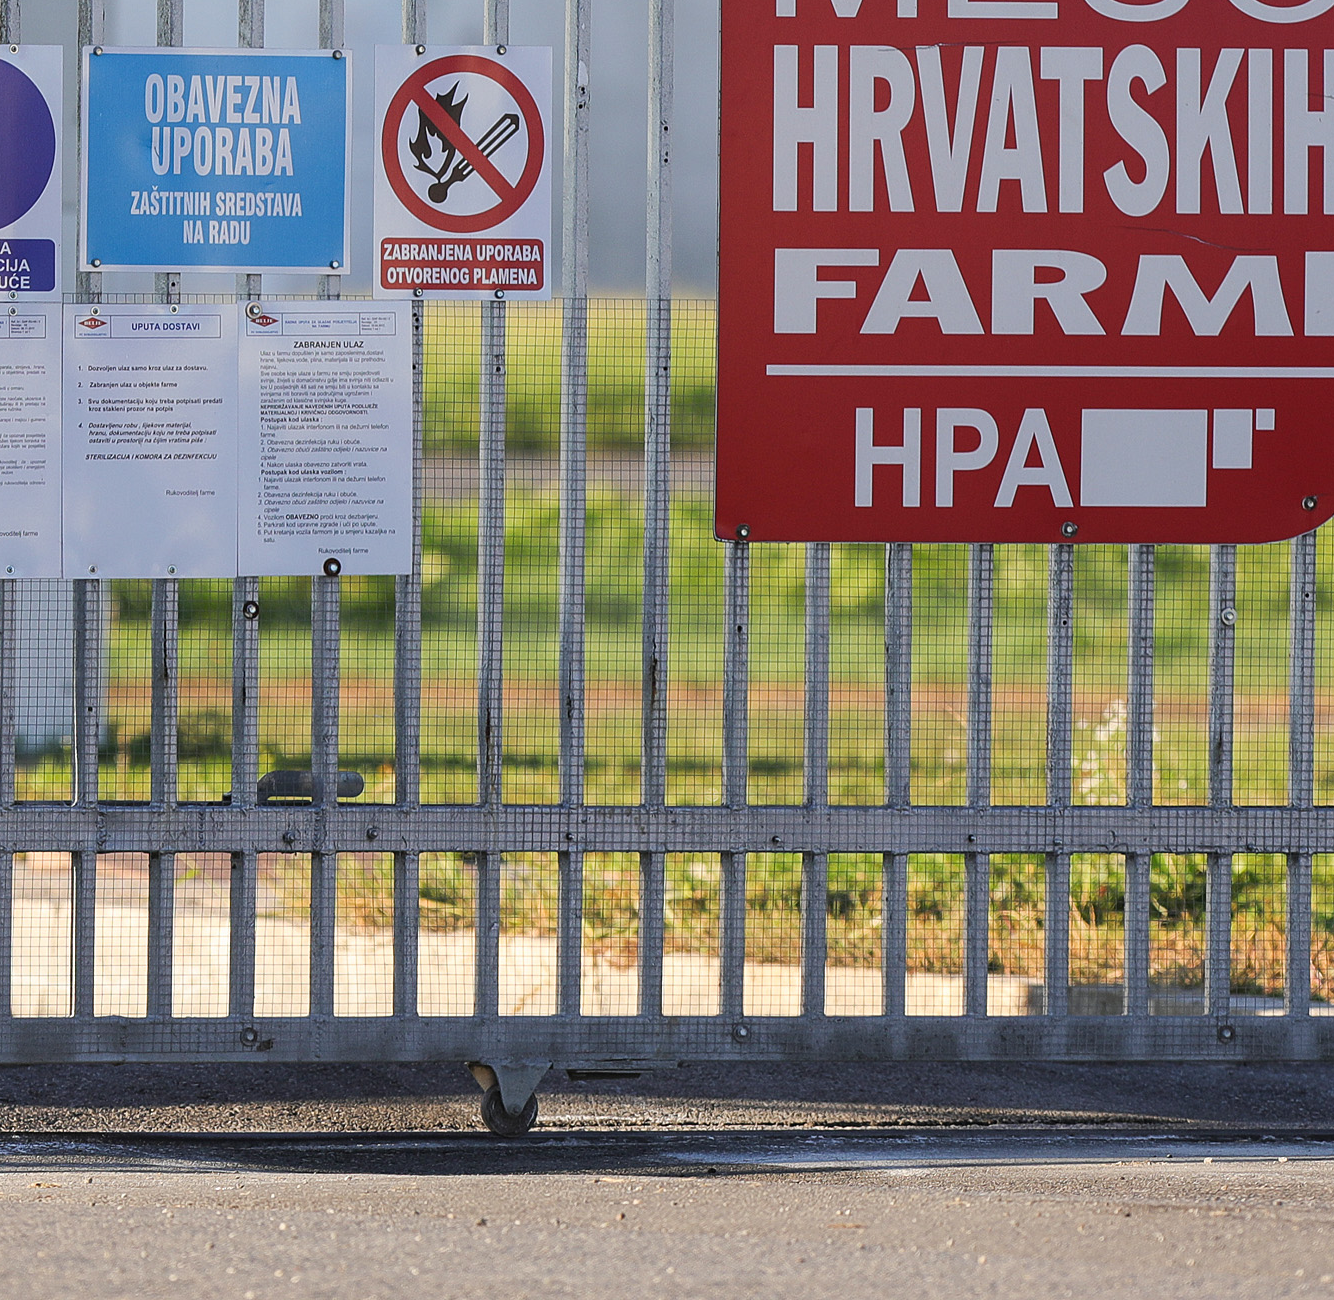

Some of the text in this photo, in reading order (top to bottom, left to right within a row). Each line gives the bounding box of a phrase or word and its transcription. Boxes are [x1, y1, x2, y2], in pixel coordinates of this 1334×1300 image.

[145, 73, 301, 124] OBAVEZNA
[151, 126, 293, 176] UPORABA
[130, 186, 301, 216] ZAŠTITNIH SREDSTAVA
[183, 220, 249, 244] NA RADU
[383, 243, 540, 261] ZABRANJENA UPORABA
[387, 267, 537, 284] OTVORENOG PLAMENA
[131, 322, 199, 330] UPUTA DOSTAVI
[854, 407, 1073, 507] HPA
